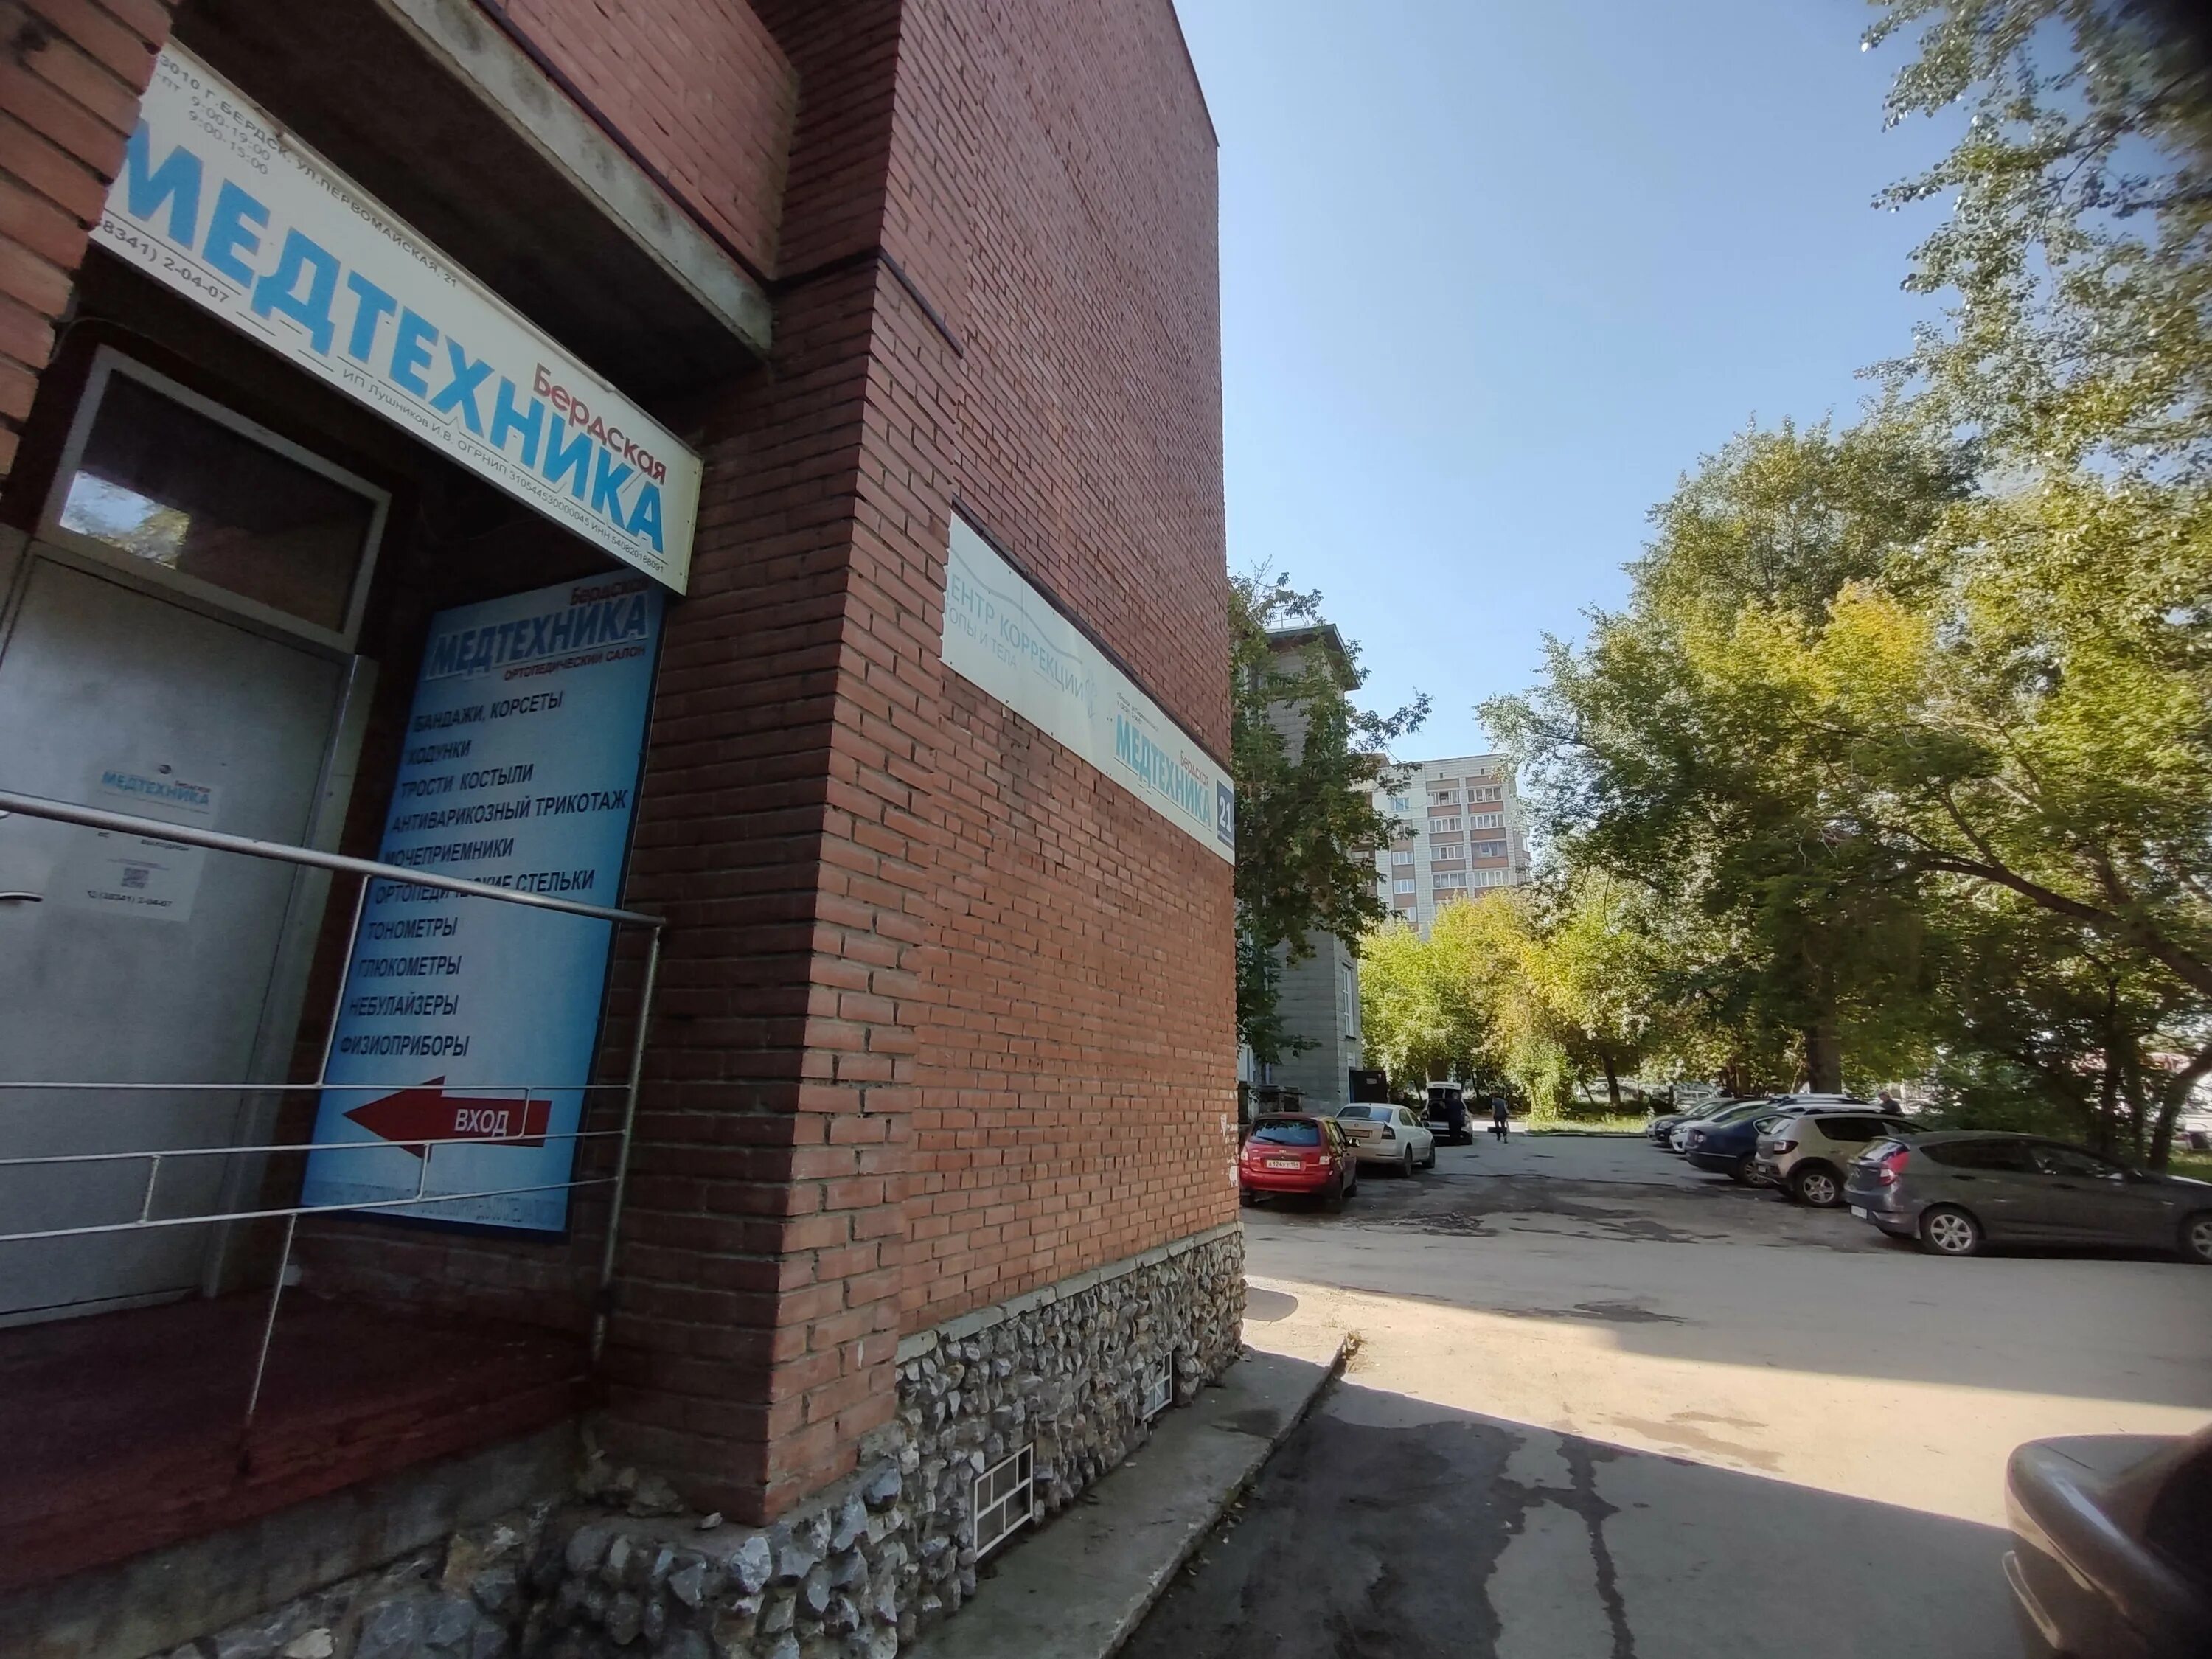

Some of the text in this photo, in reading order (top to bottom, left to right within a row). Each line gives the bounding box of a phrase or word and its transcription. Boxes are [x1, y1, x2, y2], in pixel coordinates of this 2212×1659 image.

[187, 108, 269, 175] 9:00-15:00
[191, 95, 271, 162] 9:00-19:00
[162, 256, 230, 303] 2-04-07
[442, 274, 458, 288] 21
[126, 116, 665, 555] МЕДТЕХНИКА
[532, 362, 667, 487] Бердская
[343, 369, 366, 388] ИП
[368, 383, 428, 428] Лушников
[457, 439, 507, 476] ОГРНИП
[591, 521, 611, 541] ИНН
[427, 592, 649, 679] МЕДТЕХНИКА
[946, 572, 1085, 703] ЕНТР КОРРЕКЦИИ
[979, 630, 989, 647] И
[992, 639, 1018, 671] ТЕЛА
[606, 645, 647, 662] САЛОН
[490, 691, 563, 719] КОРСЕТЫ
[407, 740, 472, 765] ХОДУНКИ
[102, 771, 209, 805] МЕДТЕХНИКА
[401, 764, 535, 799] ТРОСТИ КОСТЫЛИ
[1116, 714, 1211, 828] МЕДТЕХНИКА
[392, 790, 629, 834] АНТИВАРИКОЗНЫЙ ТРИКОТАЖ
[1219, 796, 1232, 833] 21
[383, 838, 514, 866] МОЧЕПРИЕМНИКИ
[516, 869, 595, 892] СТЕЛЬКИ
[368, 917, 458, 940] ТОНОМЕТРЫ
[358, 955, 462, 978] ГЛЮКОМЕТРЫ
[349, 990, 459, 1017] НЕБУЛАЙЗЕРЫ
[340, 1034, 470, 1057] ФИЗИОПРИБОРЫ
[454, 1108, 509, 1137] ВХОД
